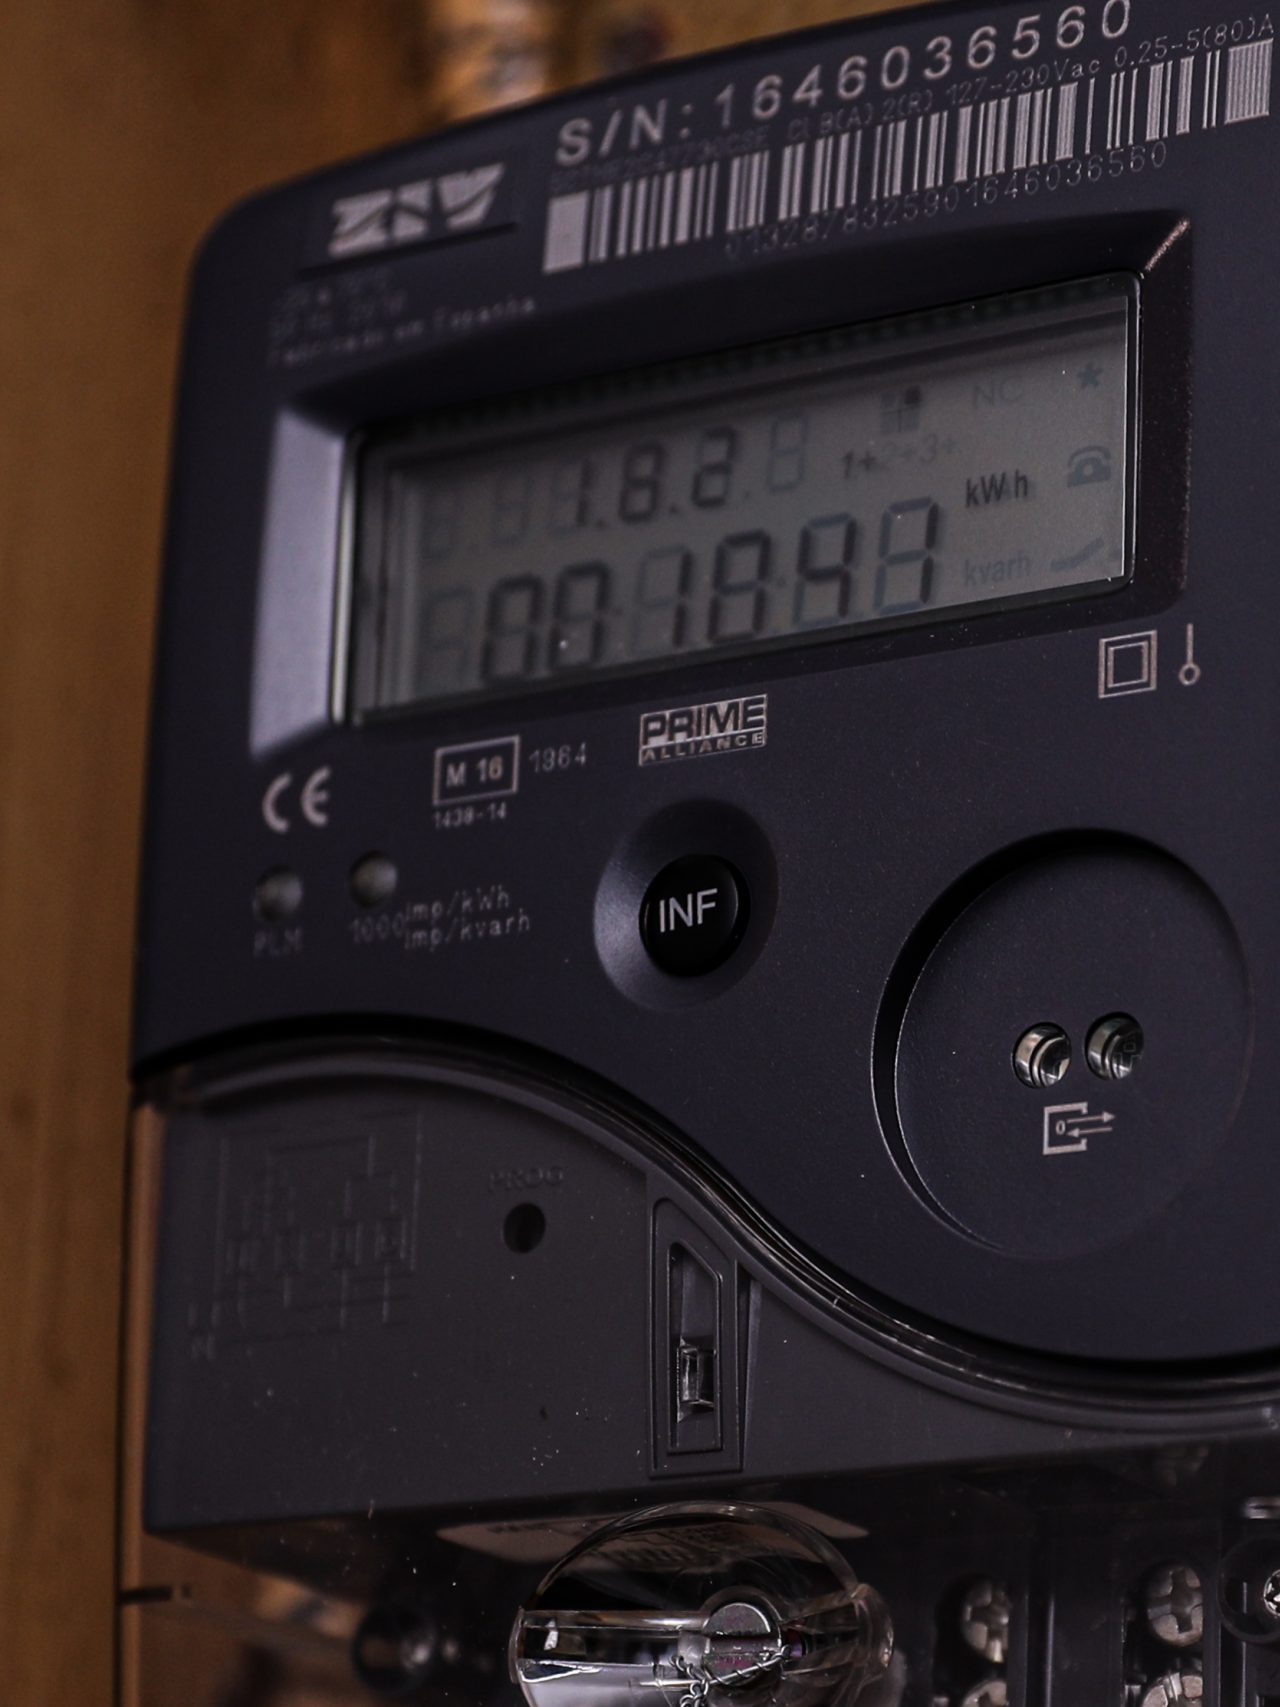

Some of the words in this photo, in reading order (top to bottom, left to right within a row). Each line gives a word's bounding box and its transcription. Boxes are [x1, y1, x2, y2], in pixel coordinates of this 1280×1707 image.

[555, 100, 693, 166] S/N:
[714, 0, 1132, 129] 1646036560
[641, 697, 767, 747] PRIME
[643, 732, 765, 762] ALLIANCE
[446, 762, 467, 787] M
[658, 888, 720, 934] INF
